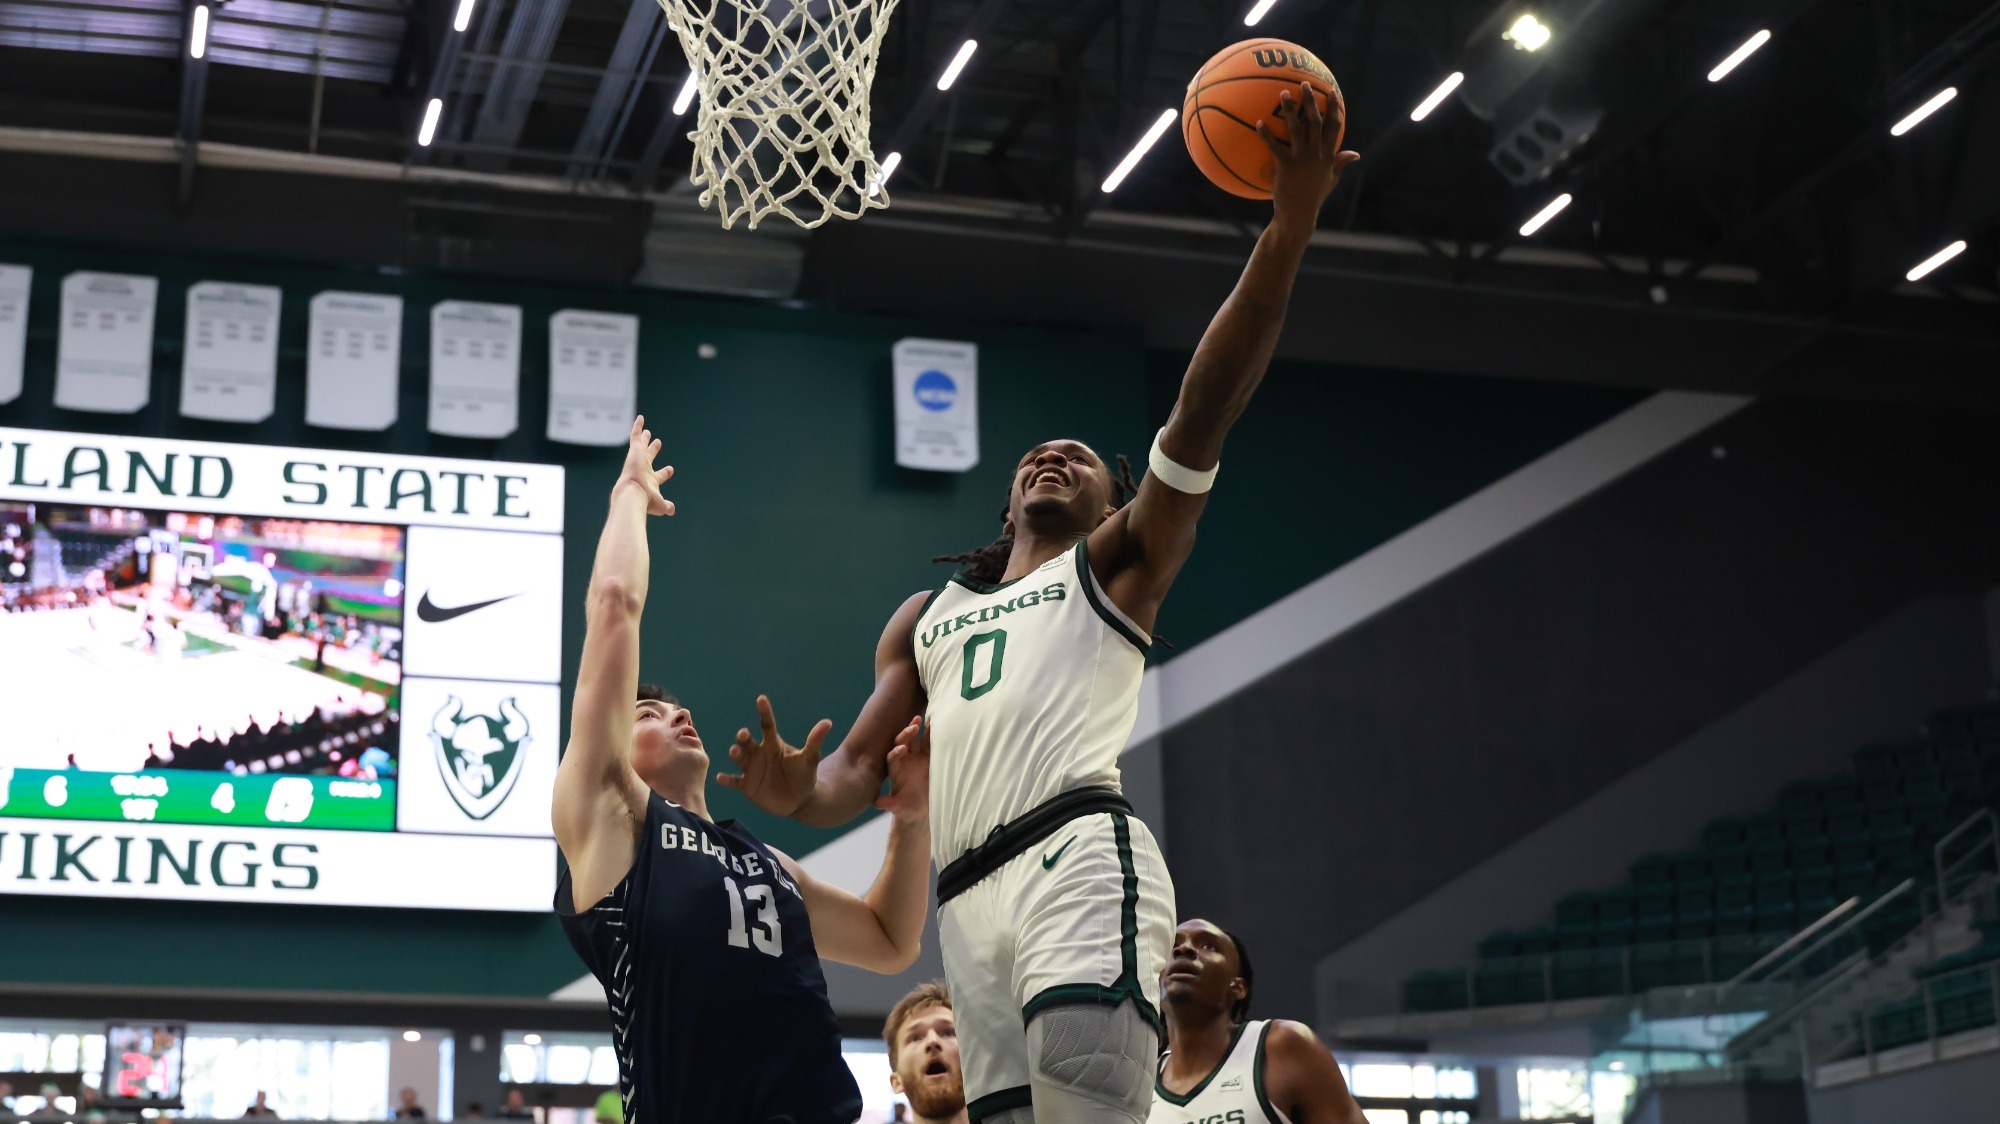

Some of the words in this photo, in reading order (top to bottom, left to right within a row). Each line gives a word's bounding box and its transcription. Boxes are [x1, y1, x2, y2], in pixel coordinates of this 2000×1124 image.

[0, 442, 233, 498] LAND
[282, 461, 531, 518] STATE
[921, 582, 1066, 649] VIKINGS
[961, 628, 1007, 701] 0
[0, 832, 319, 890] IKINGS
[724, 876, 783, 958] 13
